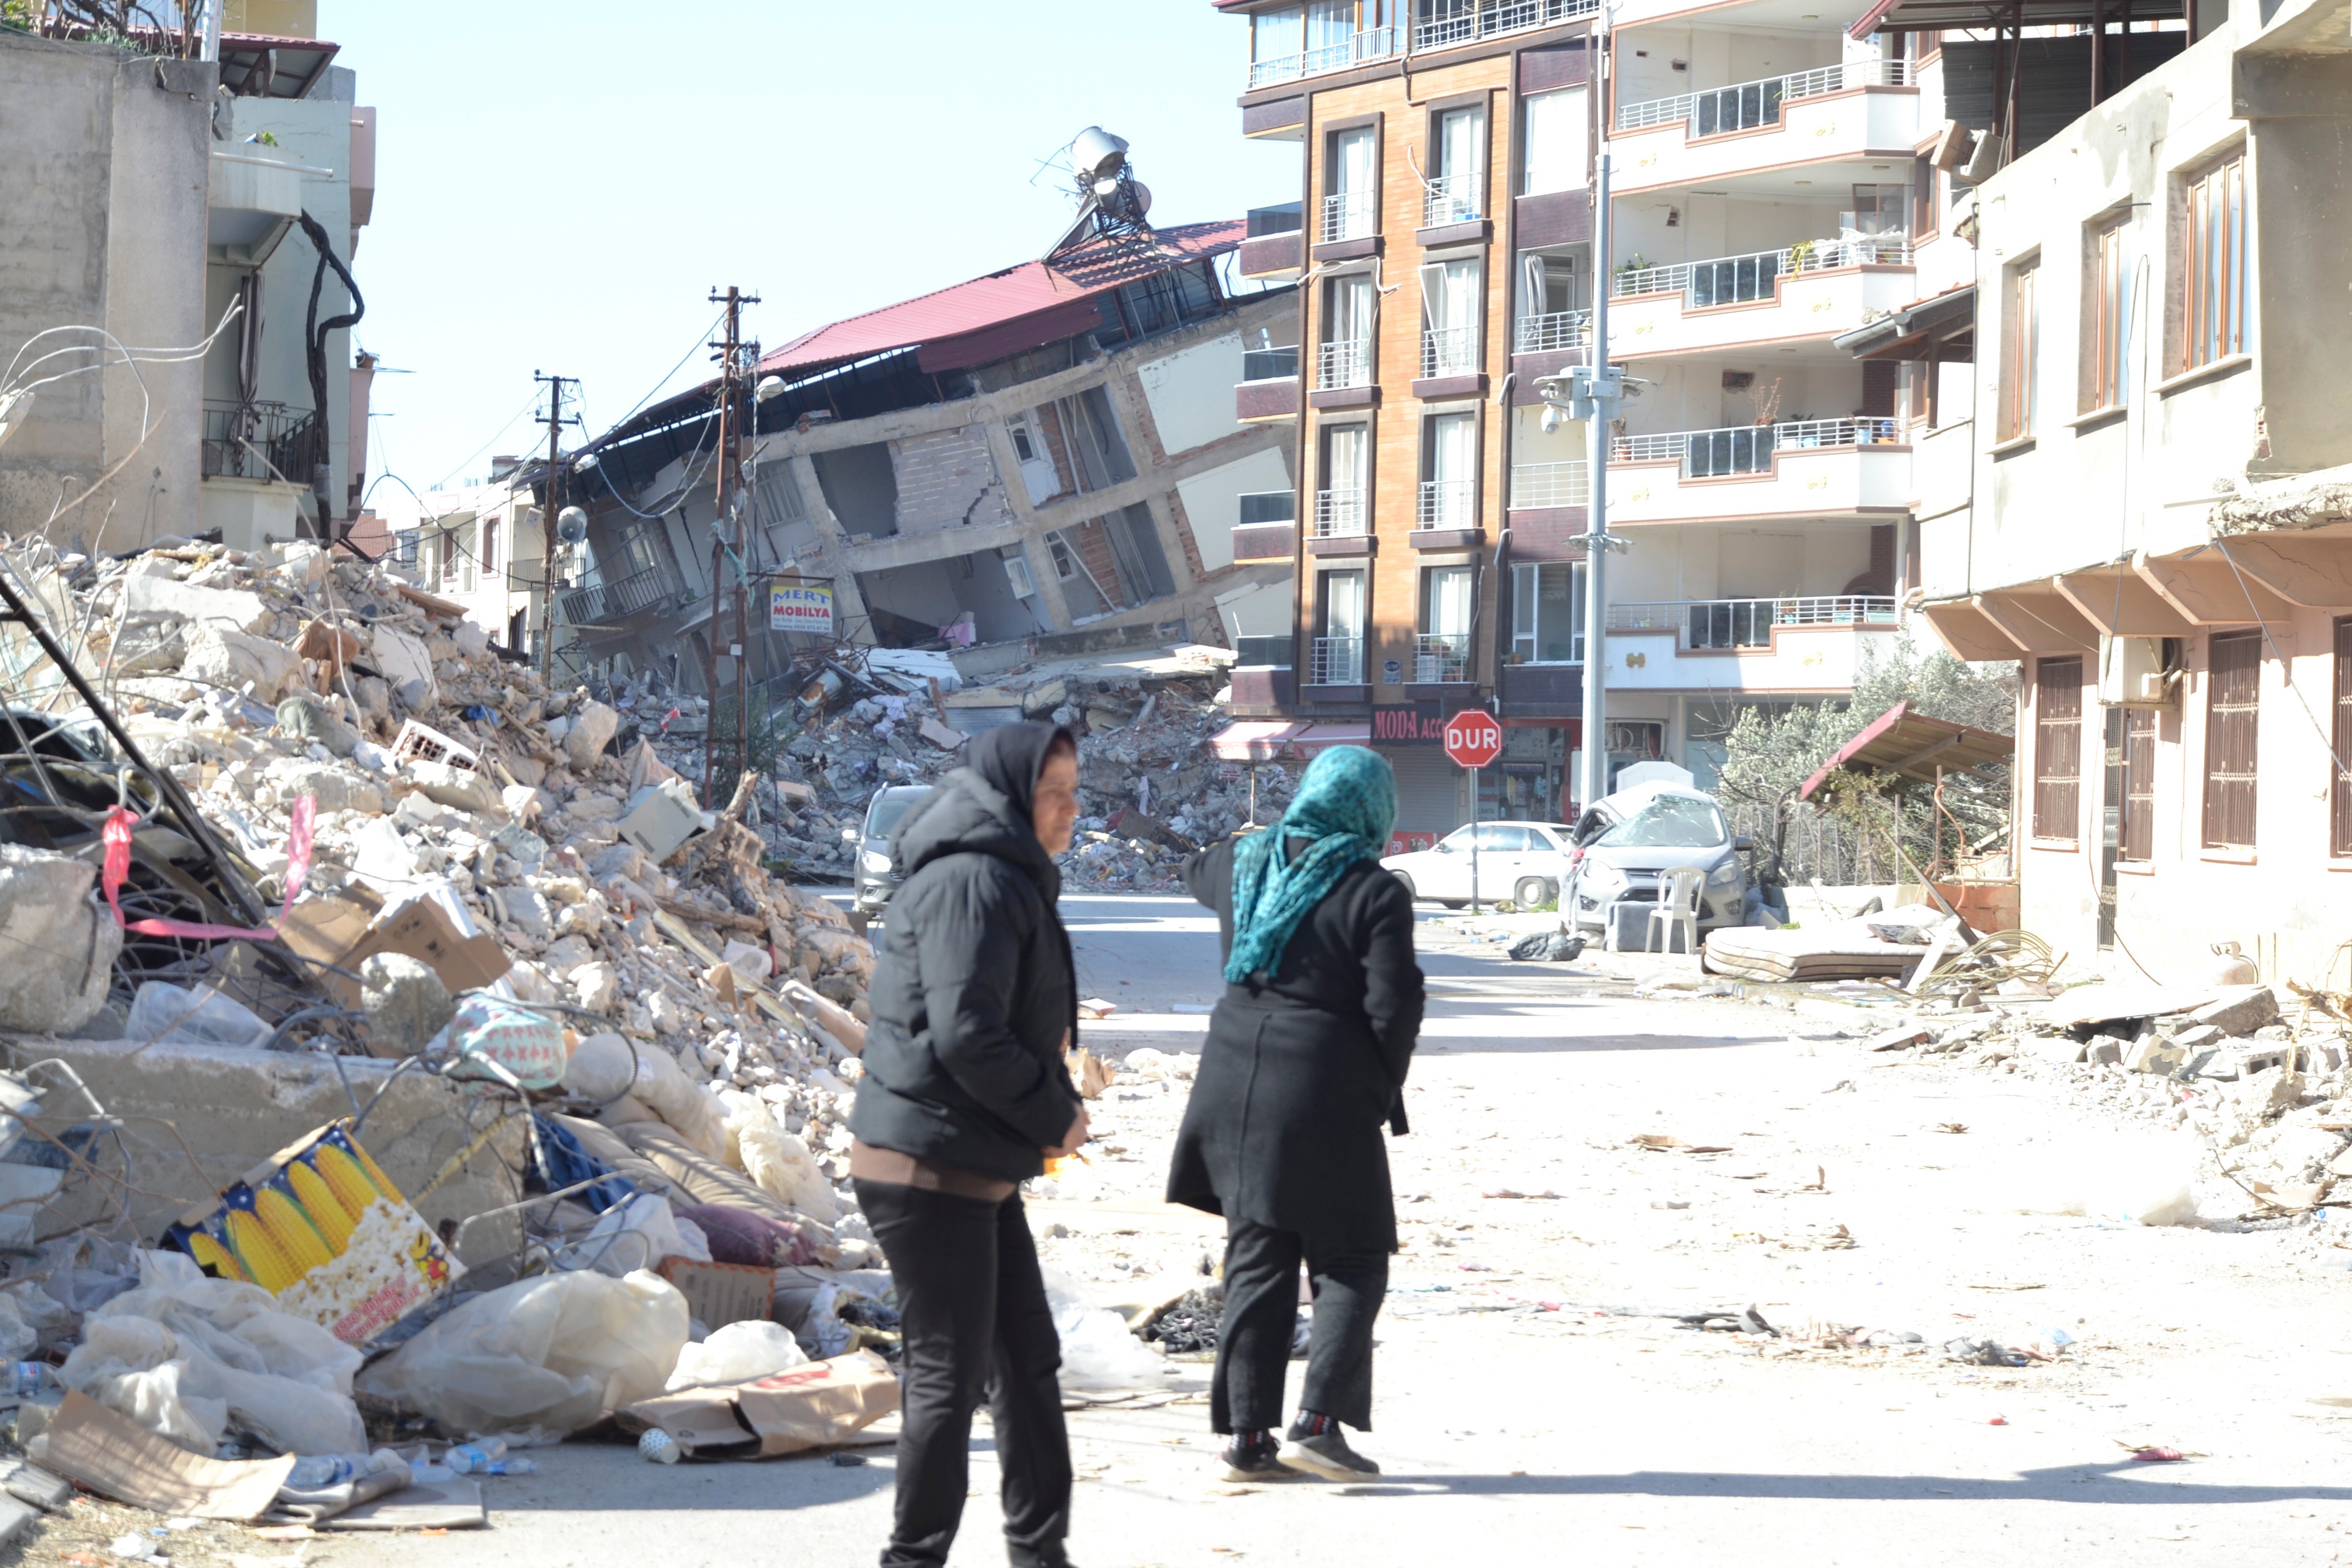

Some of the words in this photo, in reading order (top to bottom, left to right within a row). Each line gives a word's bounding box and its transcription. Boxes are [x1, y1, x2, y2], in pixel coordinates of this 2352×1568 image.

[773, 589, 830, 604] MERT
[773, 604, 830, 618] MOBİLYA
[1374, 710, 1417, 739] MODA
[1420, 718, 1445, 739] ACC
[1449, 728, 1497, 749] DUR
